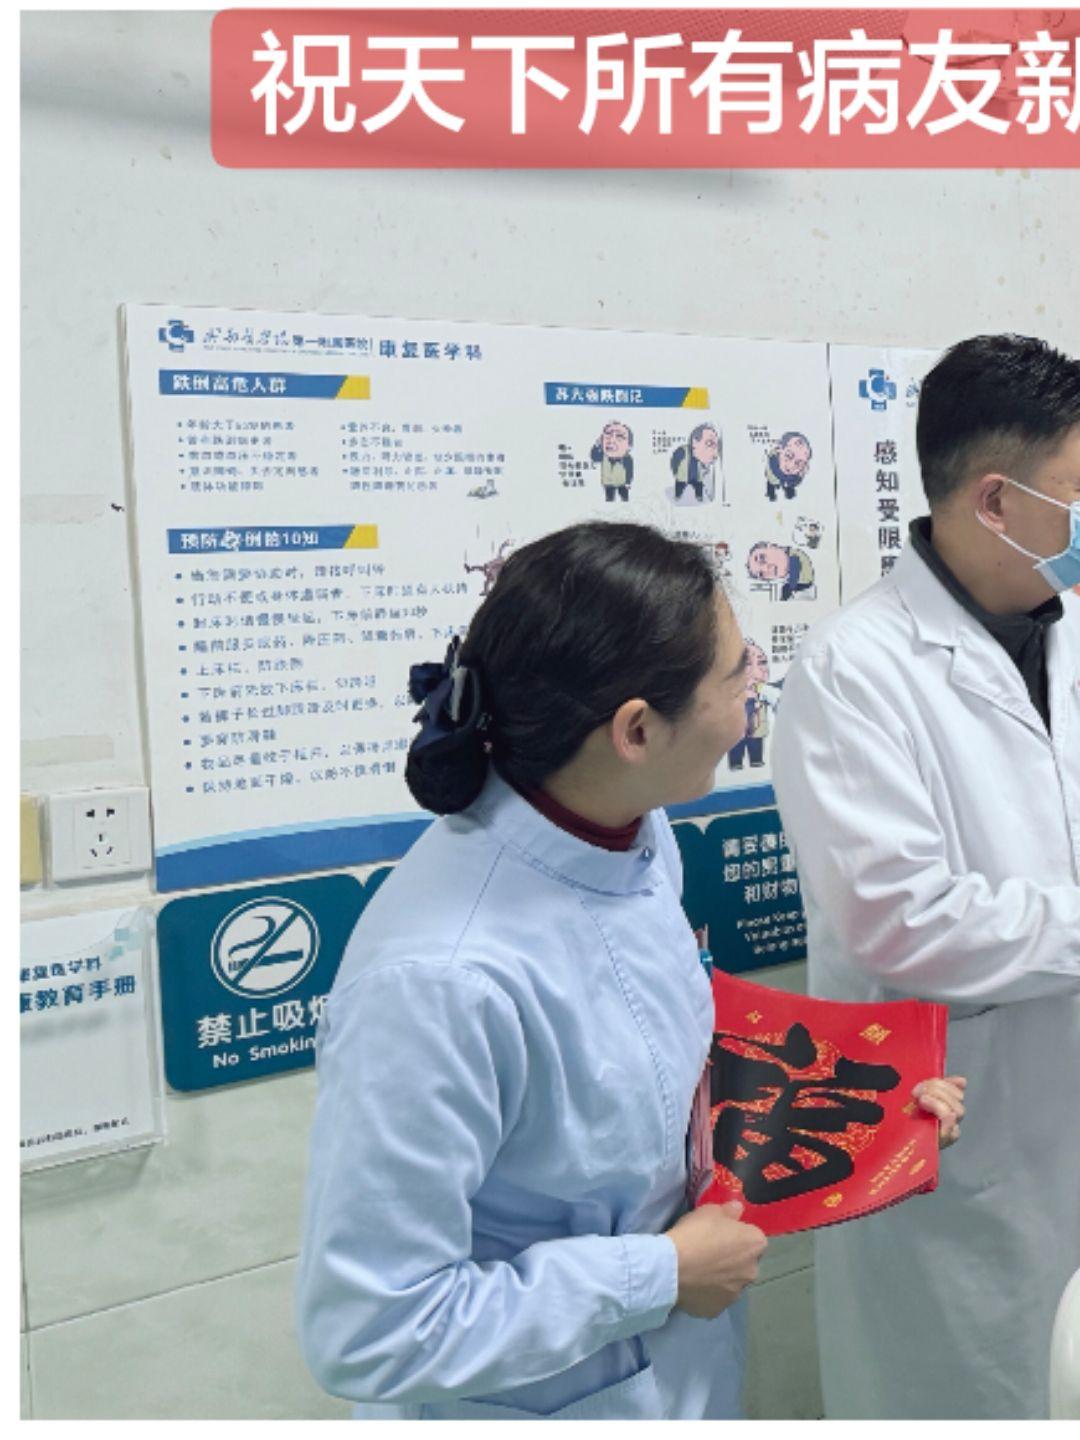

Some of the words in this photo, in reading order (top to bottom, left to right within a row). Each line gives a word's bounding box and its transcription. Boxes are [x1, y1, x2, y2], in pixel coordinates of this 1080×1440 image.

[172, 373, 288, 395] 跌倒高危人群
[213, 1051, 240, 1069] No
[249, 1035, 317, 1062] Smokin
